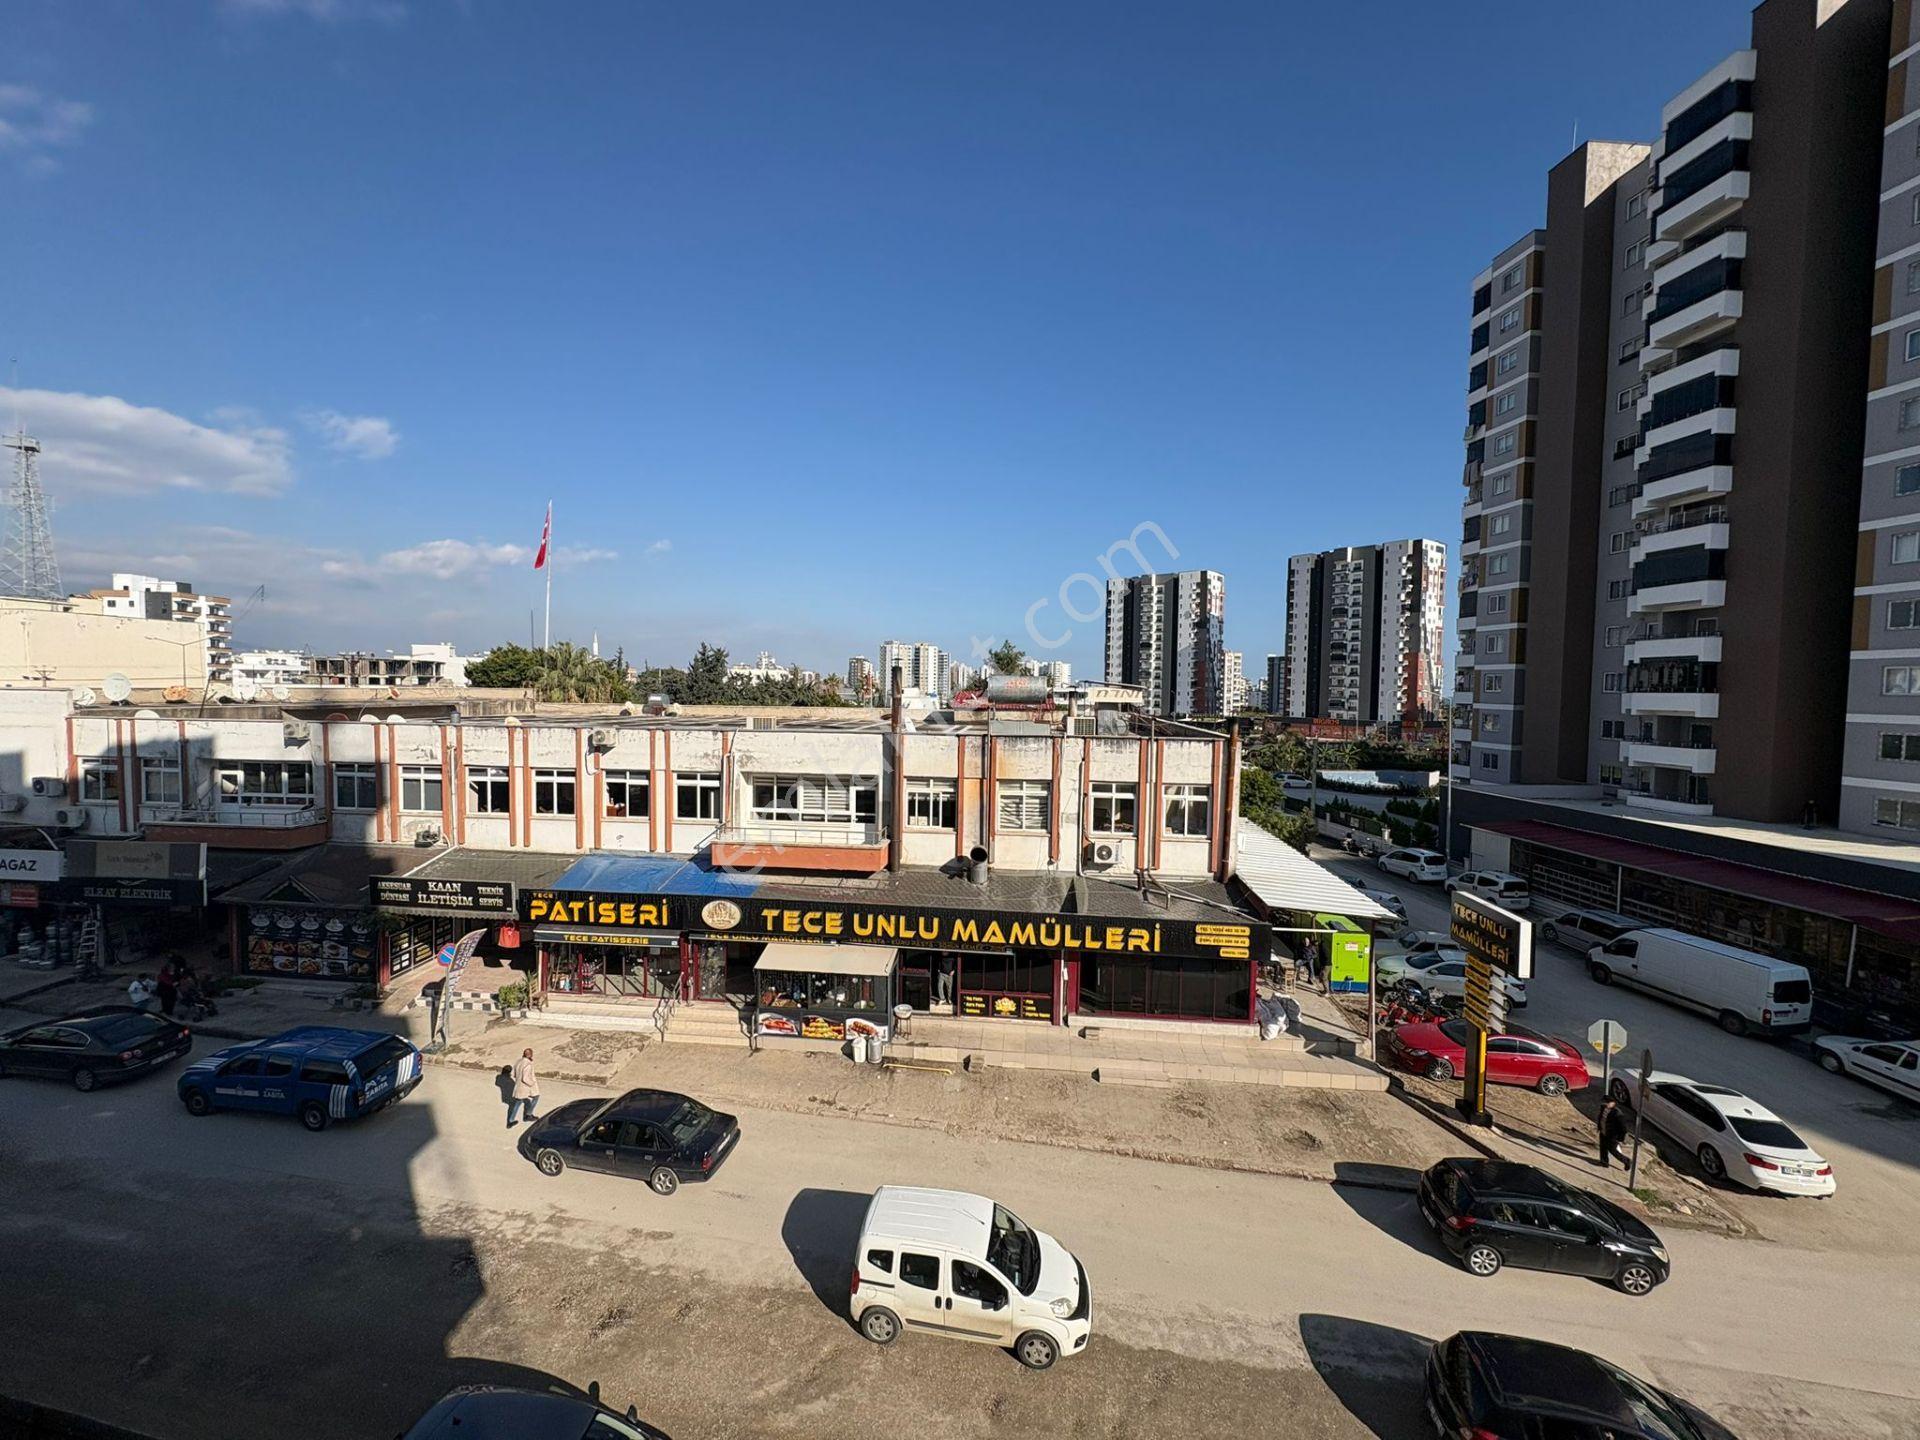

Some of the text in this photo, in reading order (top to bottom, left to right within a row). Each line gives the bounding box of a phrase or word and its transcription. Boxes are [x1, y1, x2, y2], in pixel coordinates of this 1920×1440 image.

[377, 881, 412, 891] AKSESUAR
[427, 881, 462, 893] KAAN
[477, 885, 504, 896] TEKNİK
[380, 891, 410, 902] DÜNYASI
[417, 891, 474, 907] İLETİŞİM
[478, 897, 504, 907] SERVİS
[530, 895, 669, 926] PATİSERİ
[1453, 901, 1508, 941] TECE UNLU
[760, 908, 1162, 953] TECE UNLU MAMÜLLERİ
[563, 934, 589, 942] TECE
[1450, 921, 1510, 965] MAMÜLLERİ
